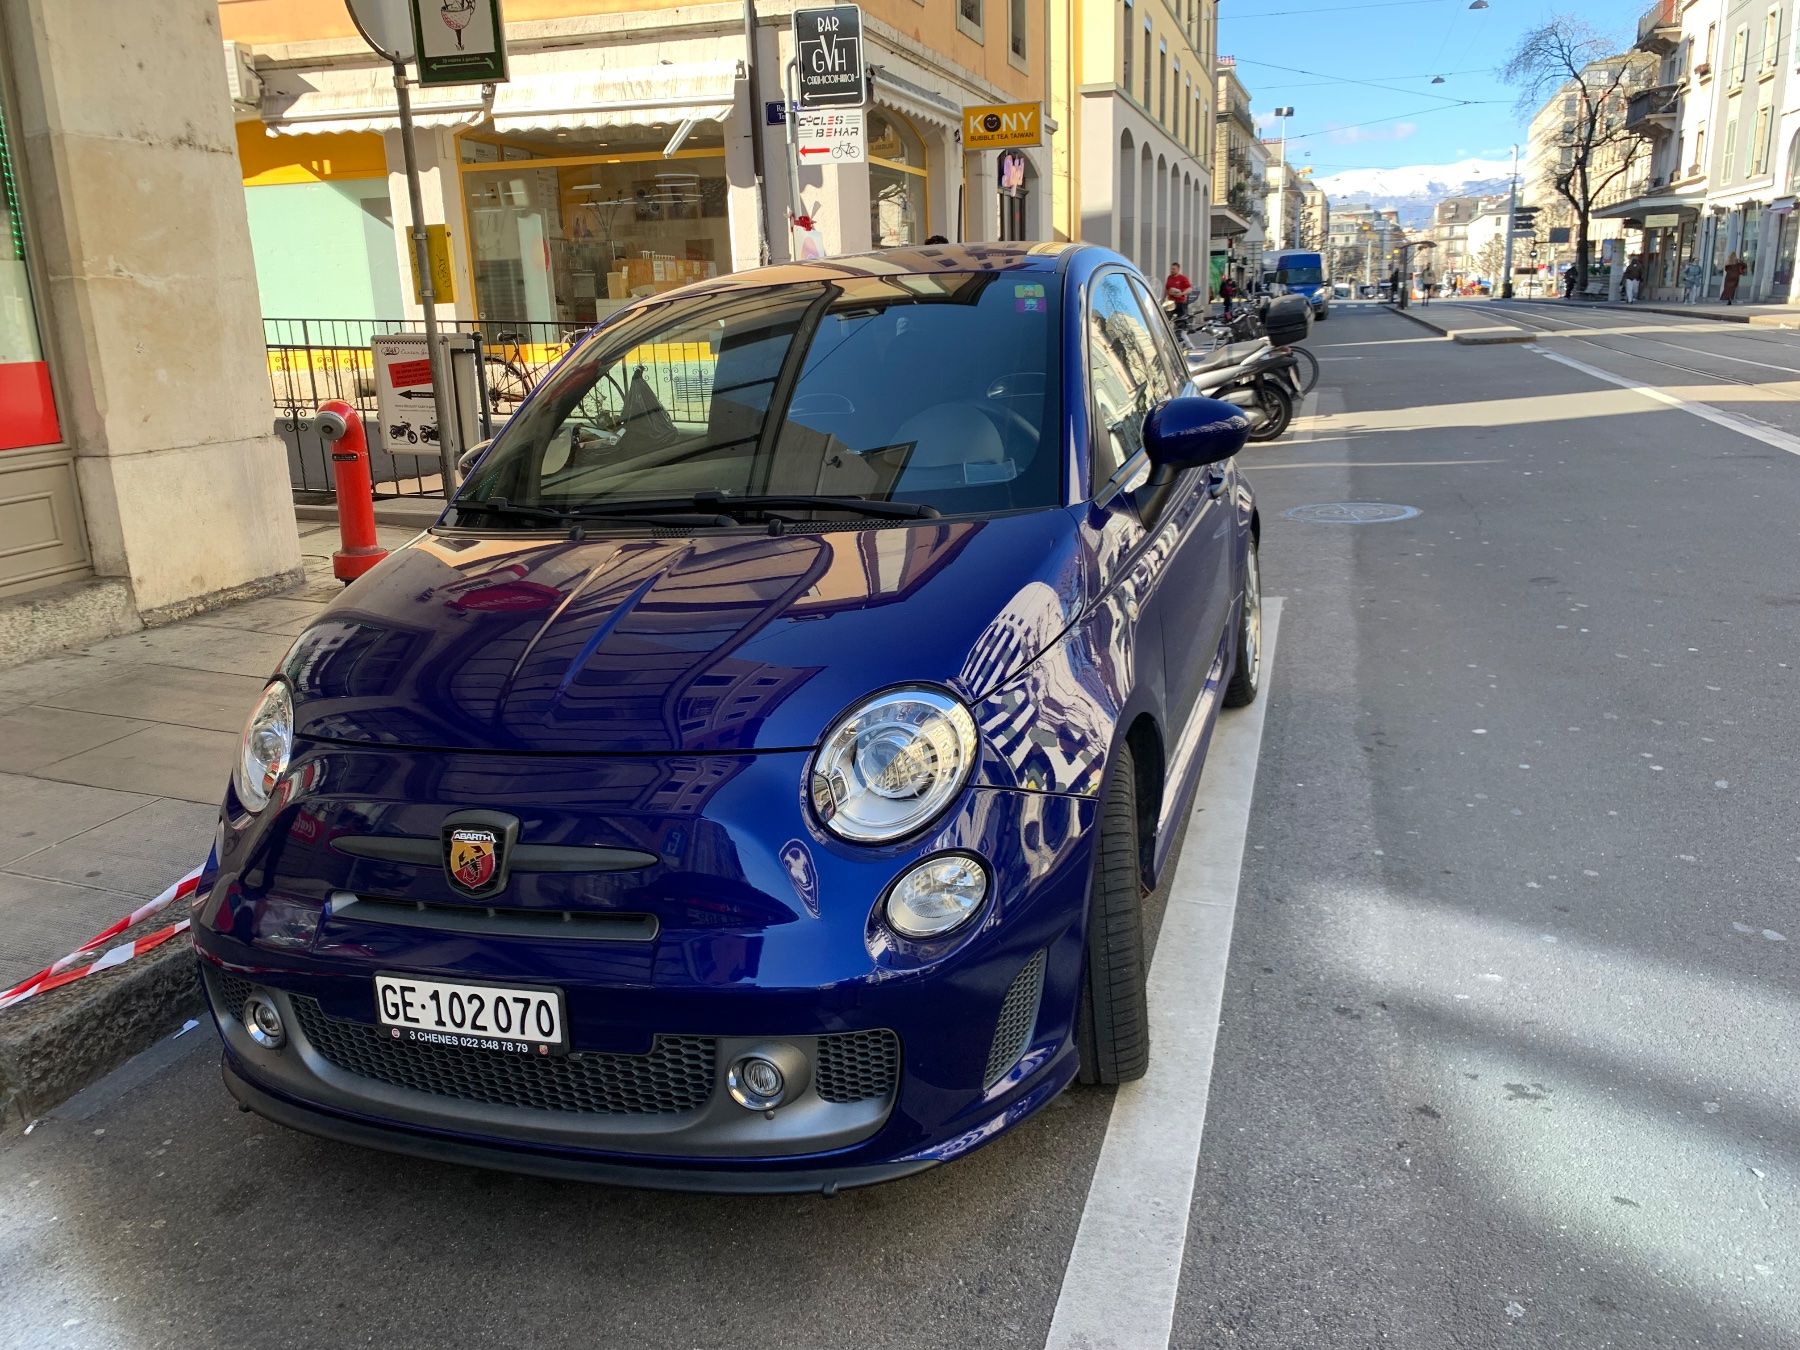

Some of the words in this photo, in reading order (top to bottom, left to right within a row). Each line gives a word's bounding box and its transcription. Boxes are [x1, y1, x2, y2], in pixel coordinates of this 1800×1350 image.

[818, 16, 839, 32] BAR
[812, 34, 846, 72] GVH
[799, 115, 844, 127] CYCLES
[815, 127, 860, 138] BEHAR
[409, 1031, 415, 1040] 3
[417, 1031, 459, 1046] CHENES
[460, 1036, 479, 1048] 022
[481, 1039, 499, 1050] 348
[501, 1041, 514, 1051] 78
[515, 1043, 528, 1053] 79
